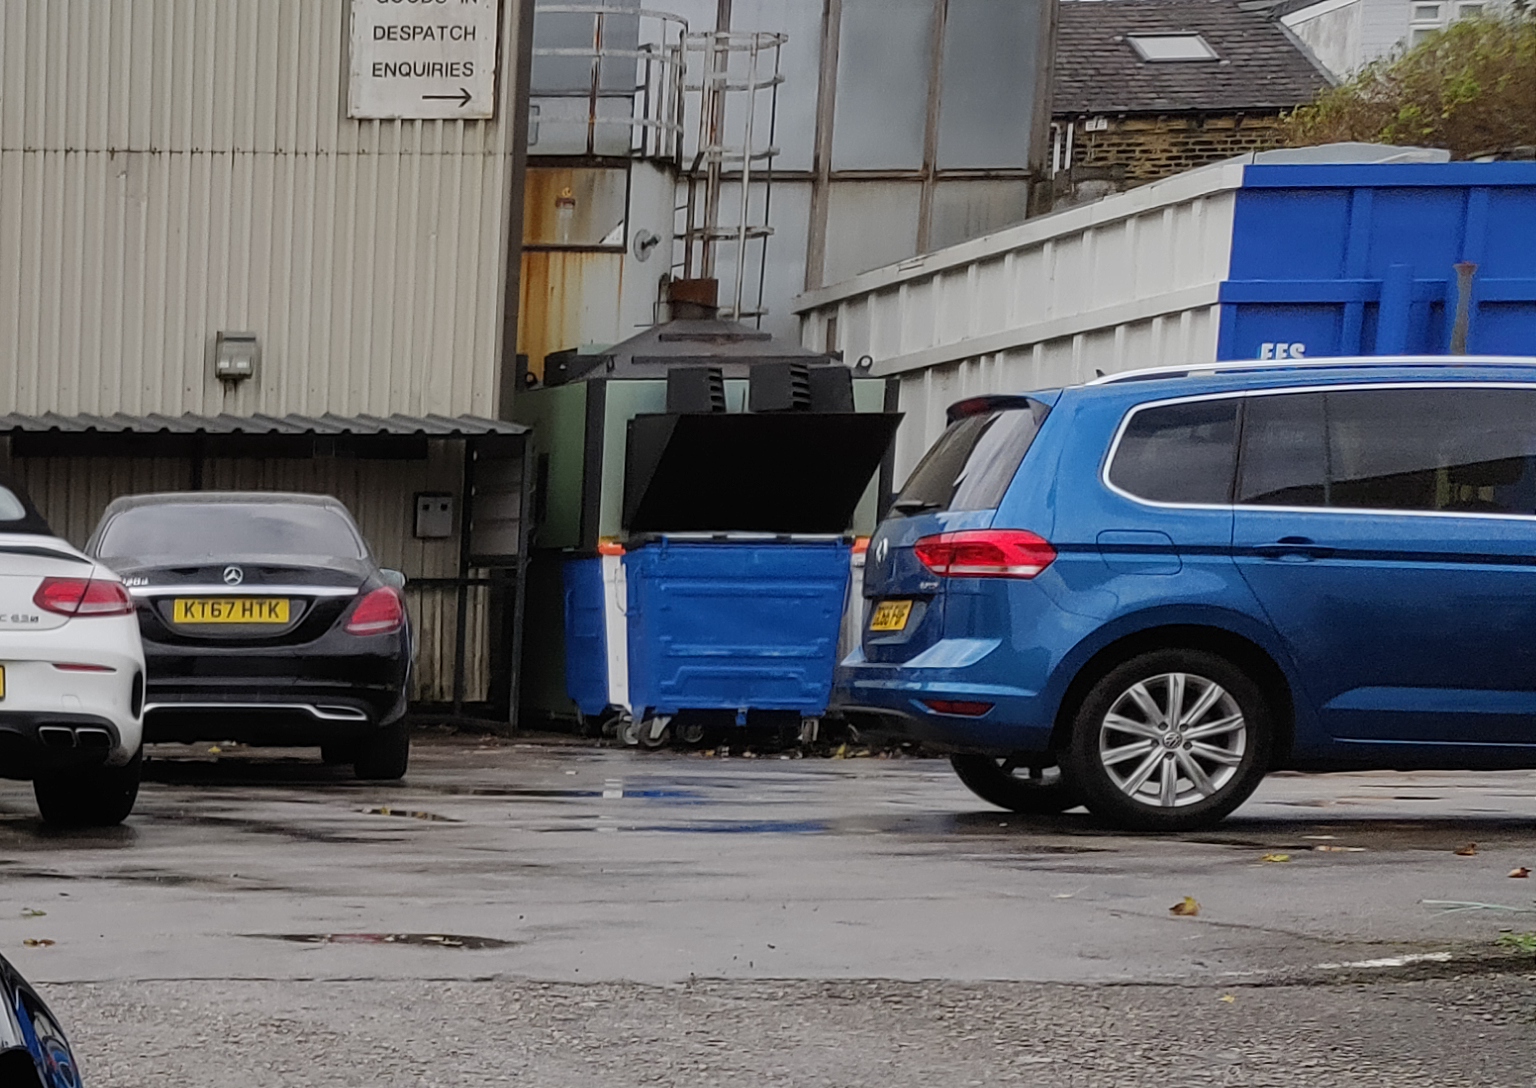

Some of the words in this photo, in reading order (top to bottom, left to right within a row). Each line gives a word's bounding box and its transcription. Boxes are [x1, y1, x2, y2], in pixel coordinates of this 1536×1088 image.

[373, 25, 476, 41] DESPATCH
[372, 61, 474, 78] ENQUIRIES
[183, 601, 236, 619] KT67
[242, 601, 280, 619] HTK
